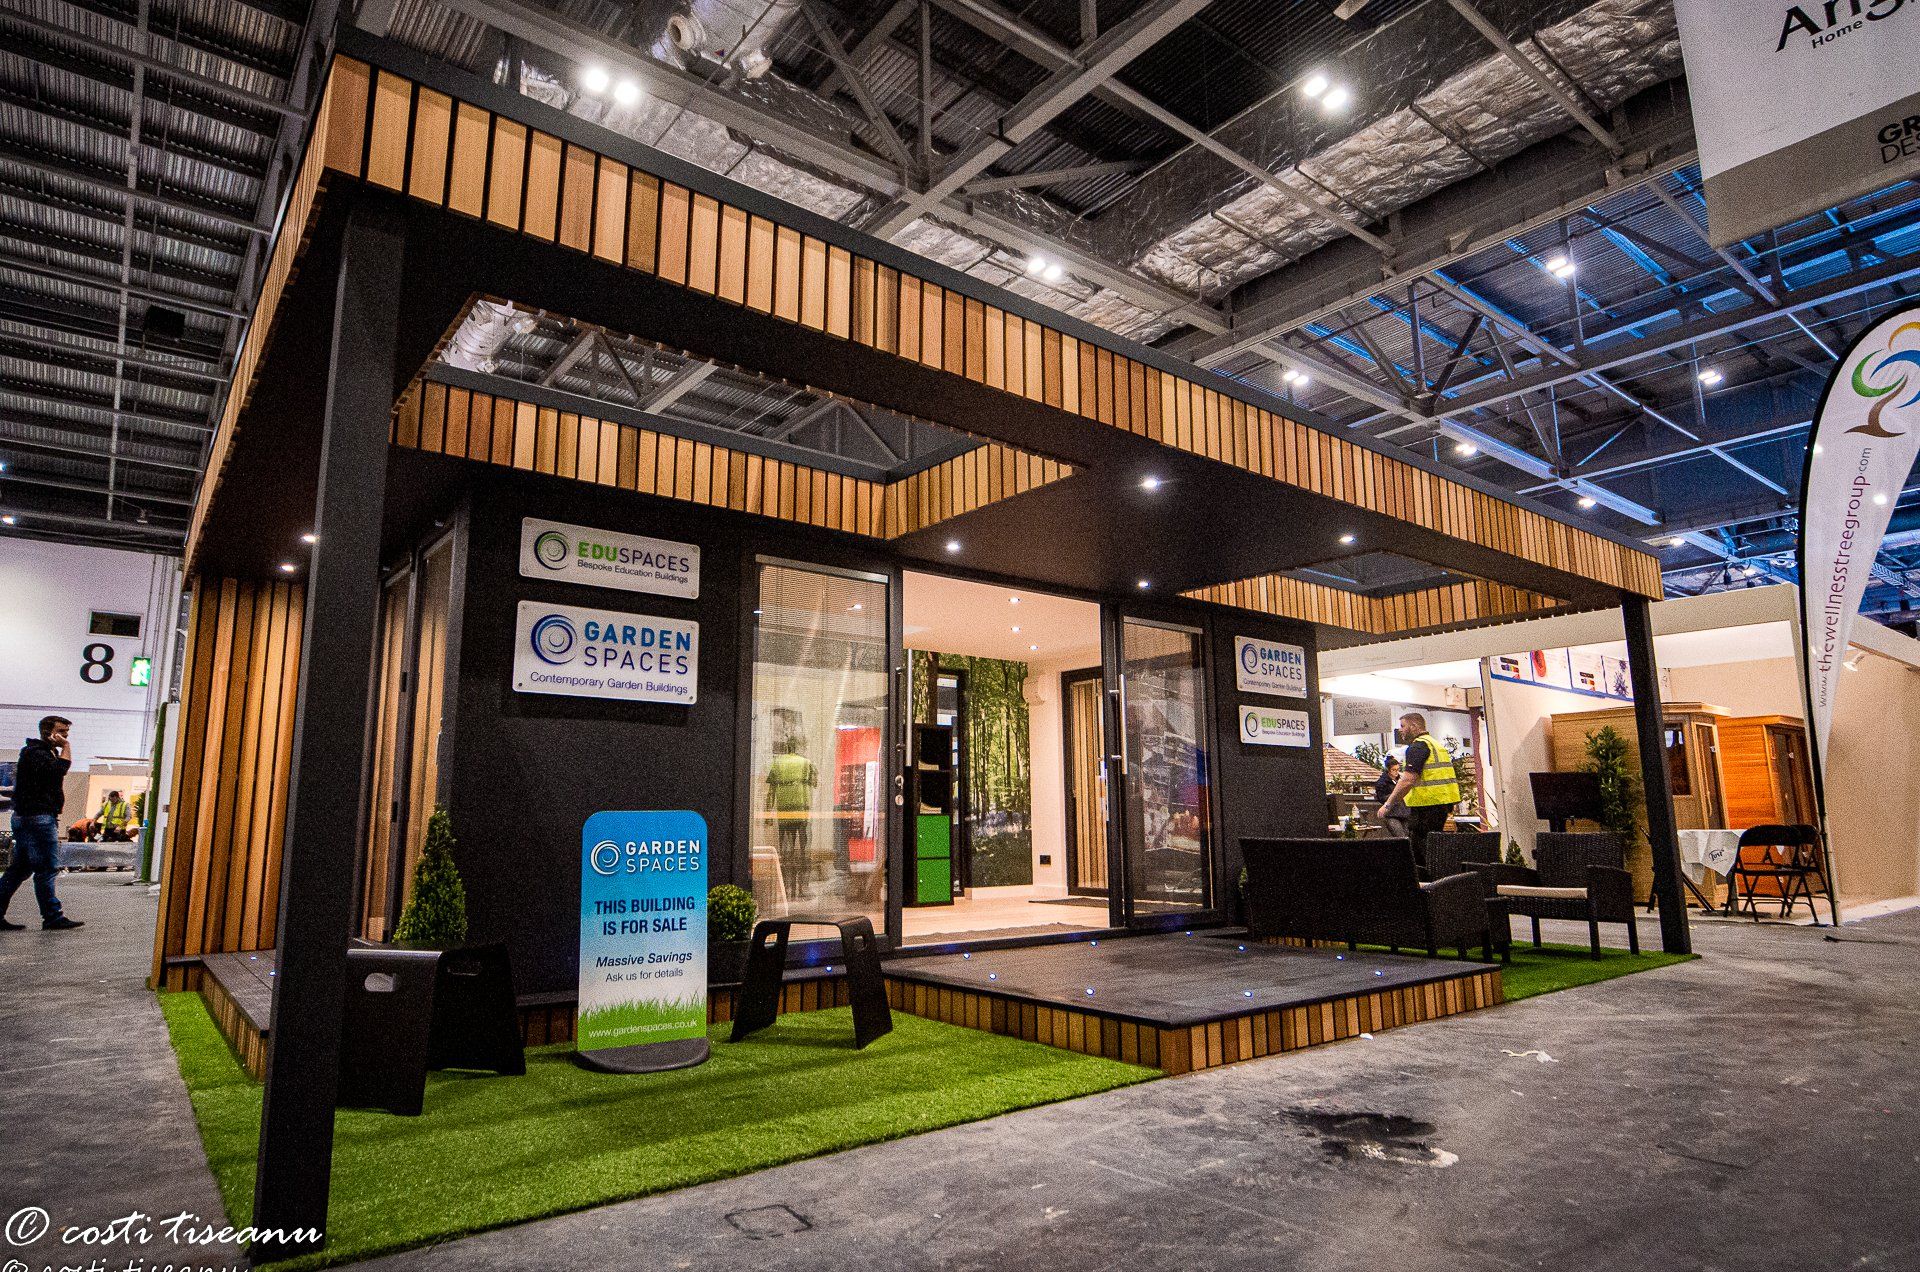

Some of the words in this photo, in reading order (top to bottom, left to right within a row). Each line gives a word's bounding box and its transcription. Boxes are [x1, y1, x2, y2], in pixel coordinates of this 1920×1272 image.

[1811, 20, 1863, 49] Home
[577, 541, 690, 573] EDUSPACES
[577, 559, 612, 572] Bespoke
[614, 565, 653, 578] Education
[654, 571, 689, 584] Buildings
[584, 621, 691, 652] GARDEN
[79, 643, 115, 685] 8
[583, 646, 688, 675] SPACES
[1260, 647, 1302, 666] GARDEN
[1261, 662, 1302, 680] SPACES
[530, 671, 604, 688] Contemporary
[607, 678, 643, 690] Garden
[645, 681, 688, 695] Buildings
[1261, 717, 1306, 731] EDUSPACES
[625, 840, 700, 856] GARDEN
[626, 856, 700, 873] SPACES
[594, 900, 627, 915] THIS
[631, 896, 695, 913] BUILDING
[603, 921, 616, 936] IS
[621, 919, 648, 934] FOR
[652, 917, 687, 932] SALE
[596, 955, 644, 968] Massive
[647, 951, 693, 965] Savings
[605, 972, 624, 983] Ask
[625, 973, 638, 981] us
[640, 970, 652, 980] for
[654, 967, 684, 979] details
[588, 1018, 698, 1038] www.gardenspaces.co.uk
